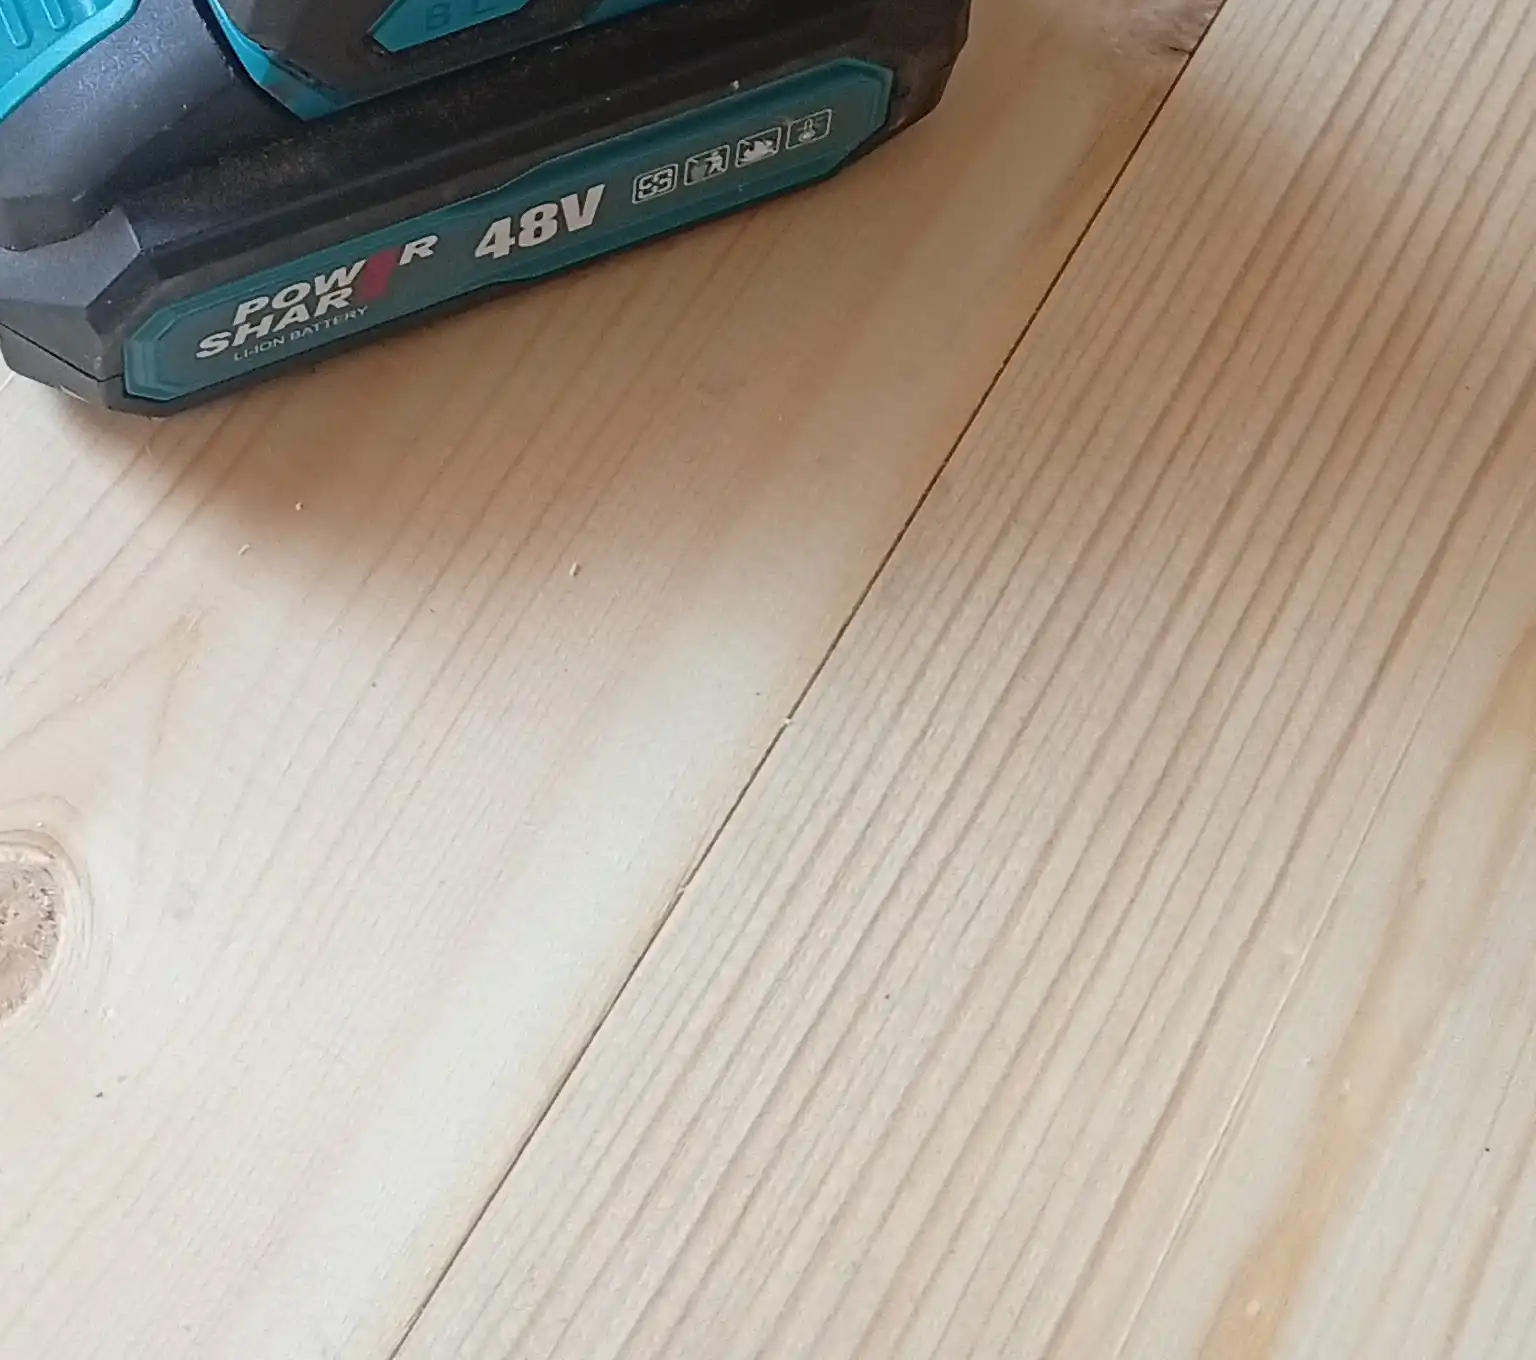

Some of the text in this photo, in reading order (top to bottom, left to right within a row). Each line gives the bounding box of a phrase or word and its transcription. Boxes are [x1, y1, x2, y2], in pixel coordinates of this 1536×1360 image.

[472, 182, 606, 261] 48V
[234, 304, 369, 362] LI-ION BATTERY
